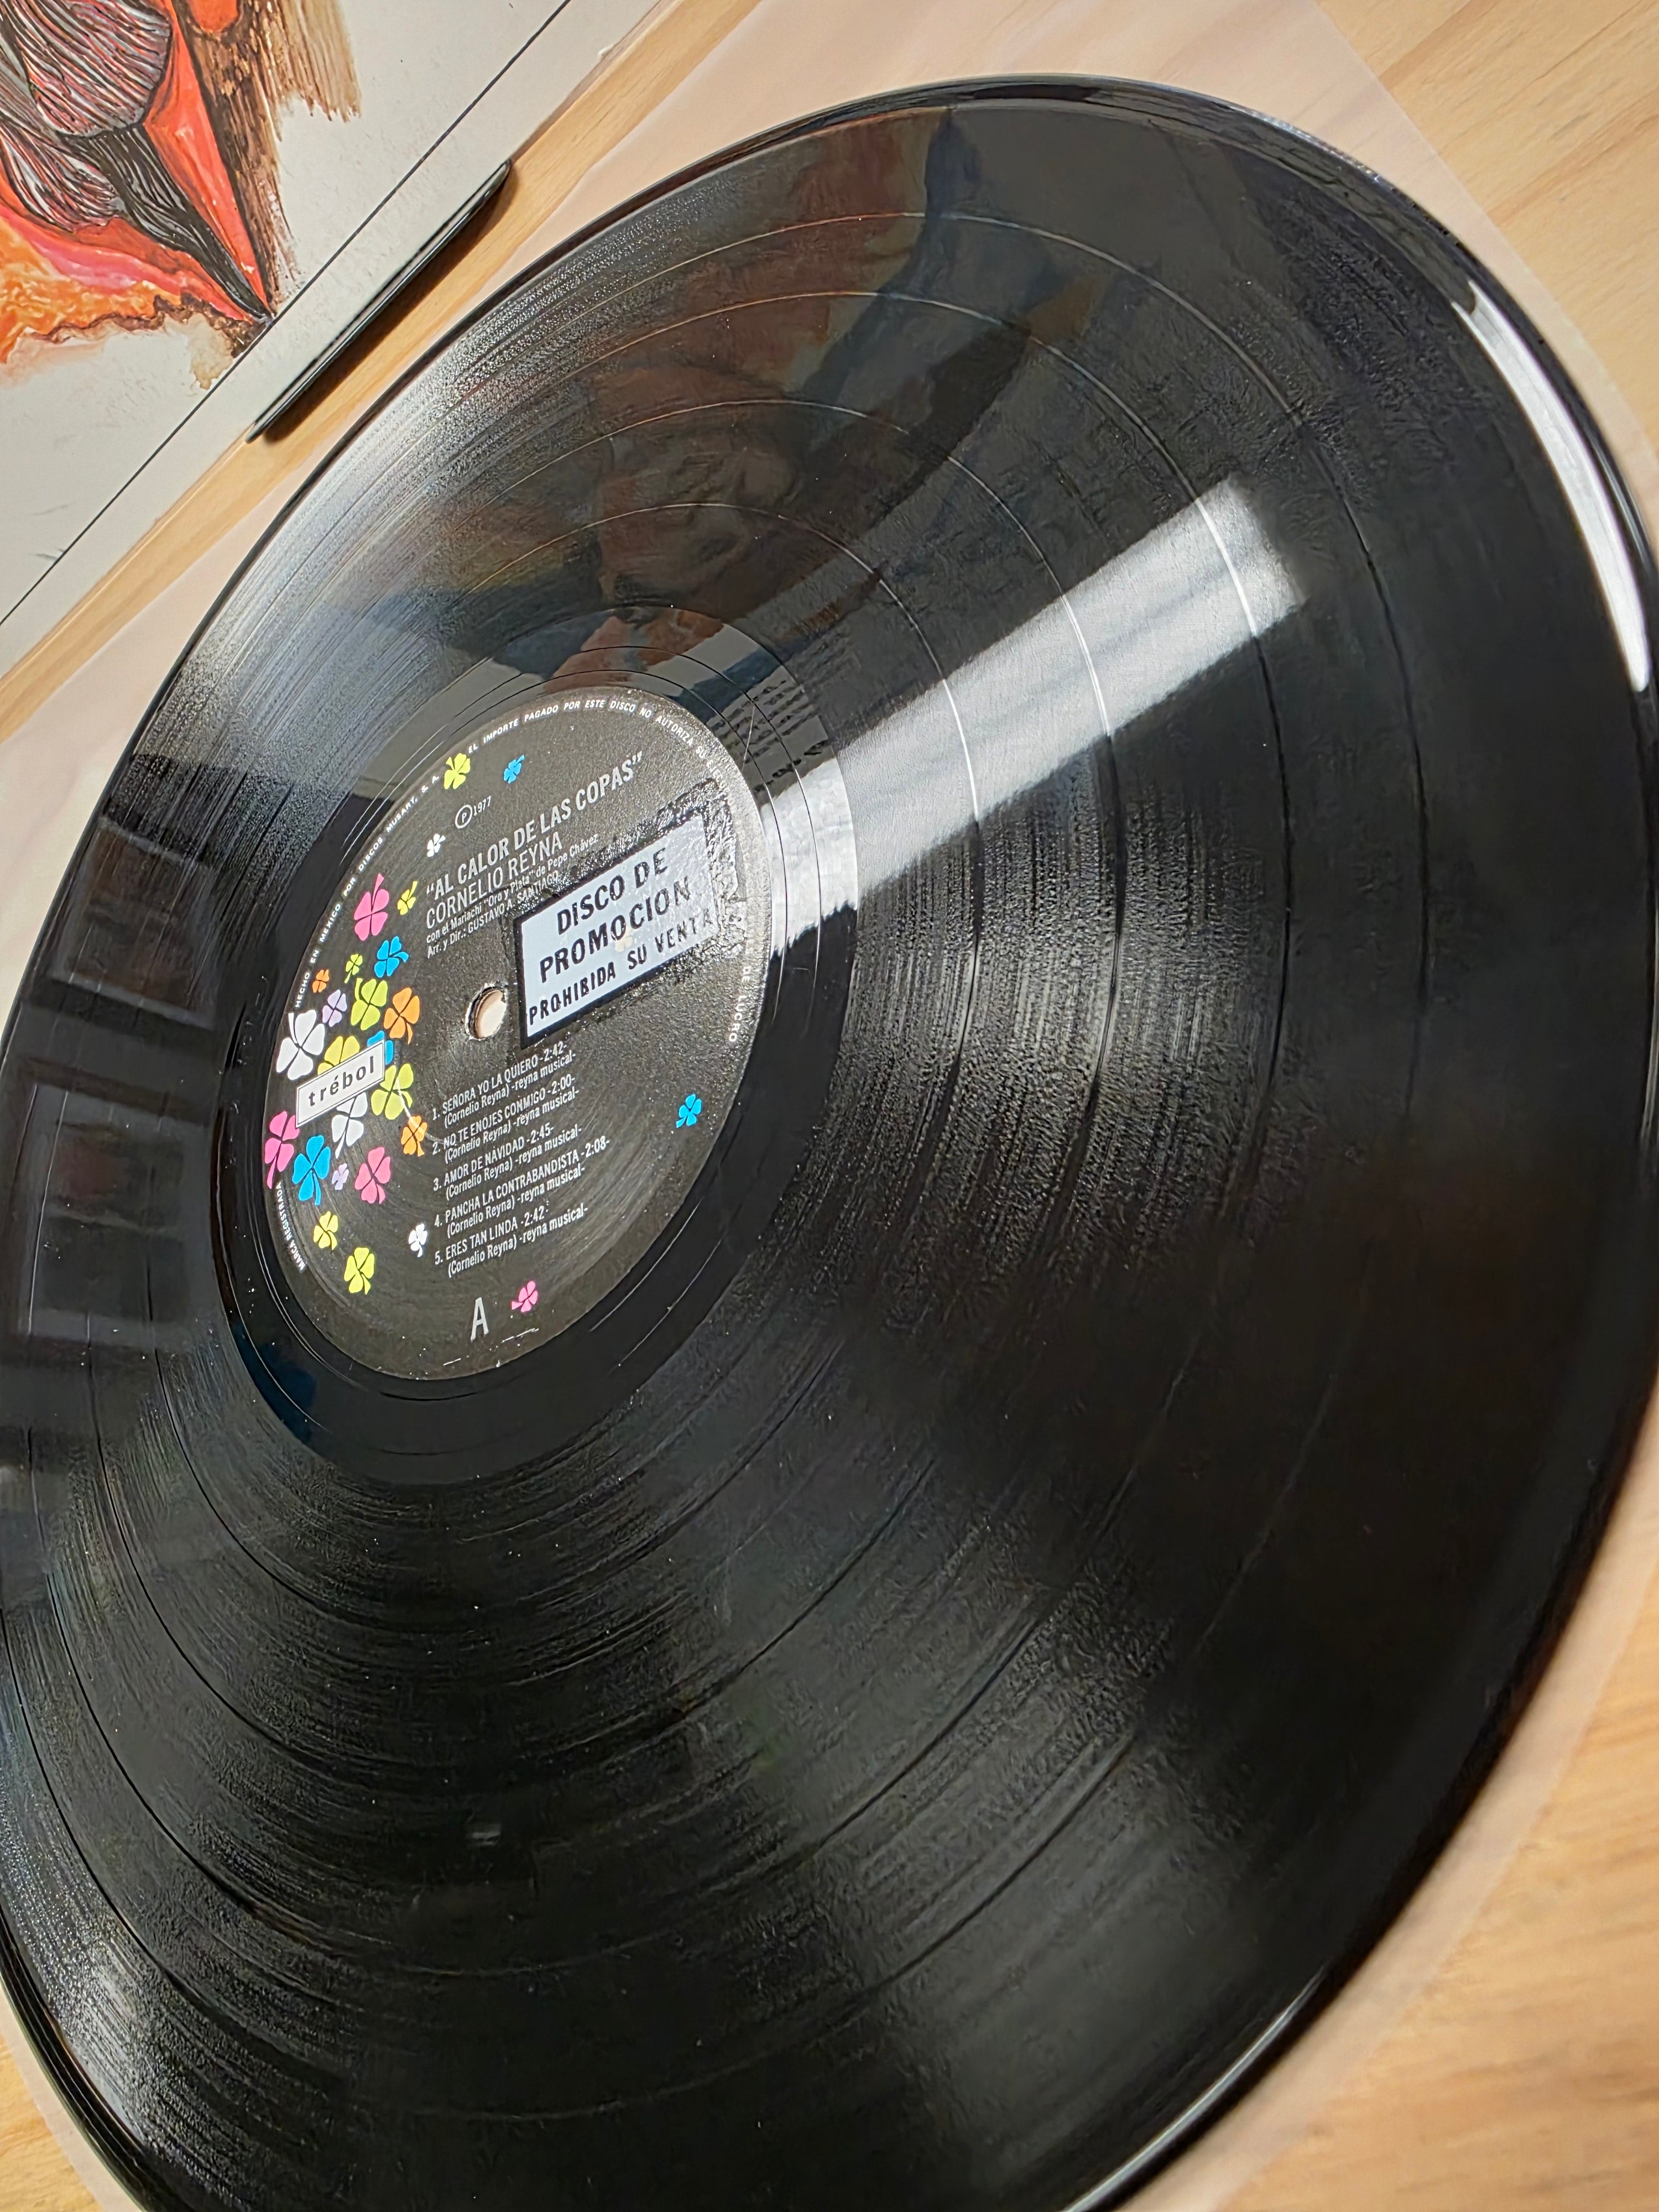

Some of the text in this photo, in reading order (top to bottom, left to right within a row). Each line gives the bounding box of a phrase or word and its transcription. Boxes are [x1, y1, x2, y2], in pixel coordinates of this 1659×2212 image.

[457, 836, 509, 882] CALOR
[513, 819, 536, 851] DE
[540, 798, 571, 833] LAS
[473, 795, 492, 816] 1977
[426, 831, 562, 930] CORNELIO REYNA
[426, 929, 440, 943] con
[442, 924, 449, 936] el
[450, 903, 482, 930] Mariachi
[504, 888, 510, 900] y
[536, 864, 545, 878] de
[548, 854, 567, 871] Pepe
[468, 743, 478, 753] EL
[483, 718, 518, 743] IMPORTE
[524, 706, 559, 722] PAGADO
[564, 701, 580, 710] POR
[585, 700, 605, 708] ESTE
[610, 701, 635, 713] DISCO
[639, 707, 652, 718] NO
[655, 715, 693, 746] AUTORIZA
[696, 745, 705, 759] SU
[729, 995, 746, 1042] LUCRO
[557, 847, 669, 935] DISCO DE
[295, 972, 310, 1008] HECHO
[310, 950, 319, 964] EN
[320, 903, 341, 942] MEXICO
[343, 877, 356, 897] POR
[358, 837, 383, 872] DISCOS
[442, 941, 447, 952] y
[468, 902, 504, 933] GUSTAVO
[517, 870, 559, 904] SANTIAGO
[540, 876, 691, 983] PROMOCION
[529, 909, 713, 1025] PROHIBIDA SU VENTA
[309, 1056, 374, 1107] trébol
[432, 1108, 440, 1120] 1.
[442, 1088, 475, 1114] SEÑORA
[478, 1079, 489, 1095] YO
[491, 1073, 503, 1088] LA
[504, 1054, 538, 1083] QUIERO
[445, 1050, 576, 1129] (Cornelio Reyna) -reyna musical-
[432, 1142, 440, 1155] 2.
[443, 1134, 456, 1149] NO
[458, 1128, 468, 1142] TE
[470, 1110, 503, 1137] ENOJES
[505, 1088, 545, 1118] CONMIGO
[445, 1086, 580, 1164] (Cornelio Reyna) -reyna musical-
[434, 1178, 441, 1191] 3.
[444, 1166, 468, 1187] AMOR
[471, 1156, 483, 1172] DE
[485, 1137, 524, 1165] NAVIDAD
[434, 1214, 442, 1227] 4.
[445, 1196, 480, 1223] PANCHA
[483, 1190, 494, 1206] LA
[496, 1149, 579, 1199] CONTRABANDISTA
[446, 1124, 582, 1201] (Cornelio Reyna) -reyna musical-
[447, 1162, 585, 1239] (Cornelio Reyna) -reyna musical-
[276, 1181, 305, 1272] MARCA REGISTRADA
[435, 1251, 442, 1265] 5.
[446, 1239, 467, 1260] ERES
[469, 1230, 487, 1249] TAN
[489, 1217, 518, 1240] LINDA
[448, 1203, 588, 1278] (Cornelio Reyna) -reyna musical-
[471, 1297, 489, 1342] A
